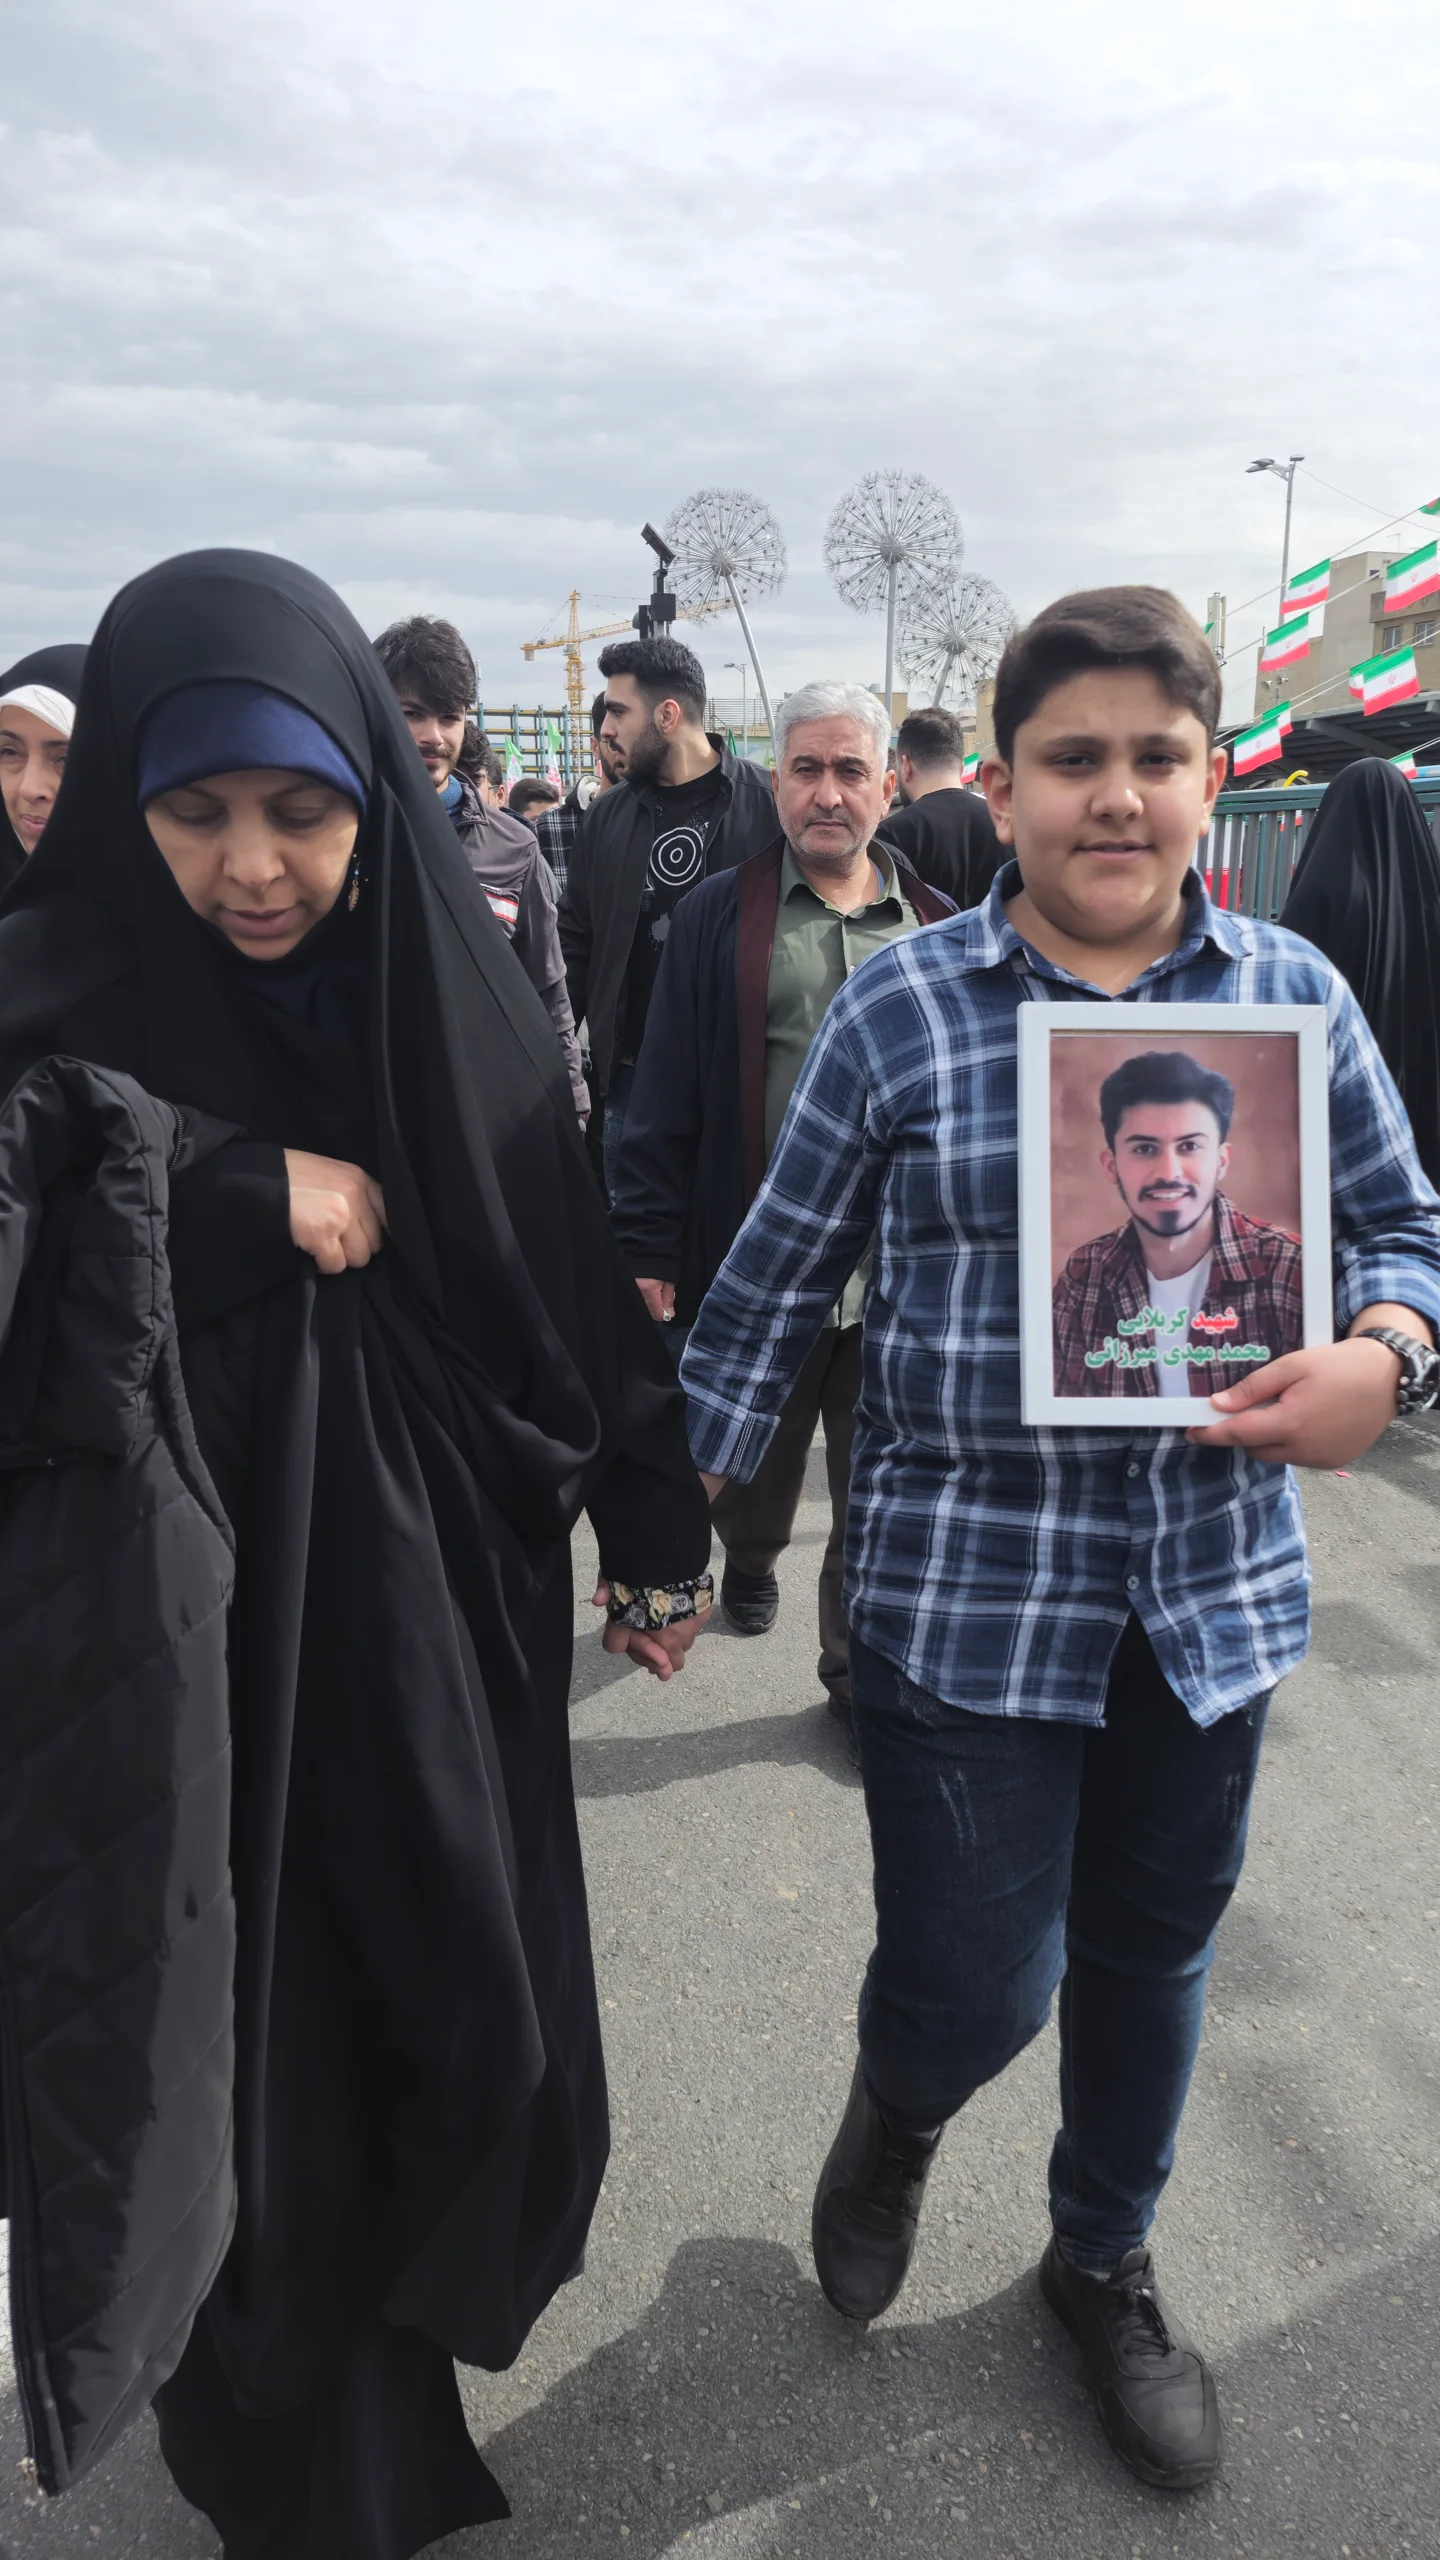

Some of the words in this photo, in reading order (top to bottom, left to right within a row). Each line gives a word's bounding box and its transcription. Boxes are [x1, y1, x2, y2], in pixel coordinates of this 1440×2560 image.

[1117, 1306, 1187, 1333] کربلایی
[1192, 1307, 1238, 1332] شهید
[1162, 1343, 1215, 1366] مهدی
[1218, 1344, 1270, 1361] محمد
